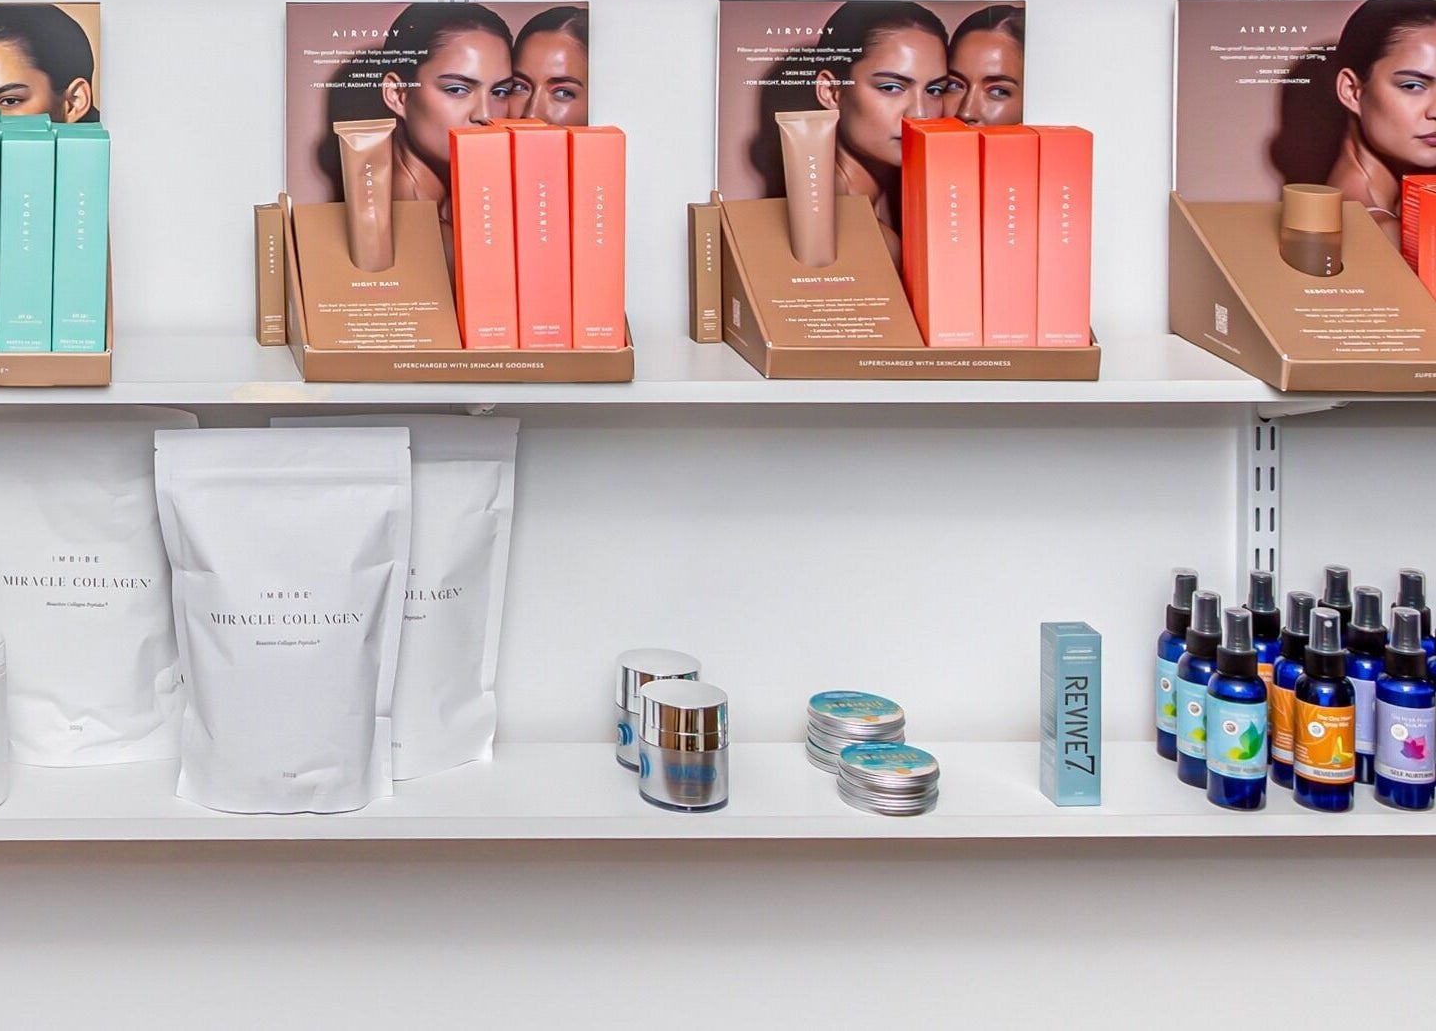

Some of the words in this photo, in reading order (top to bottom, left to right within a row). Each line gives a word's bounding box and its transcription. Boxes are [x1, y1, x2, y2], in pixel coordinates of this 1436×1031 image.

[332, 30, 399, 38] AIRYDAY
[766, 27, 834, 35] AIRYDAY
[482, 185, 492, 245] AIRYDAY
[539, 182, 548, 242] AIRYDAY
[596, 185, 604, 245] AIRYDAY
[77, 191, 85, 251] AIRYDAY
[858, 359, 914, 368] SUPERCHARGED
[915, 359, 935, 368] WITH
[936, 359, 970, 368] SKINCARE
[972, 359, 1011, 368] GOODNESS
[51, 555, 100, 563] IMBIBE
[2, 575, 67, 588] MIRACLE
[209, 612, 277, 626] MIRACLE
[1405, 770, 1434, 779] NURTURIN
